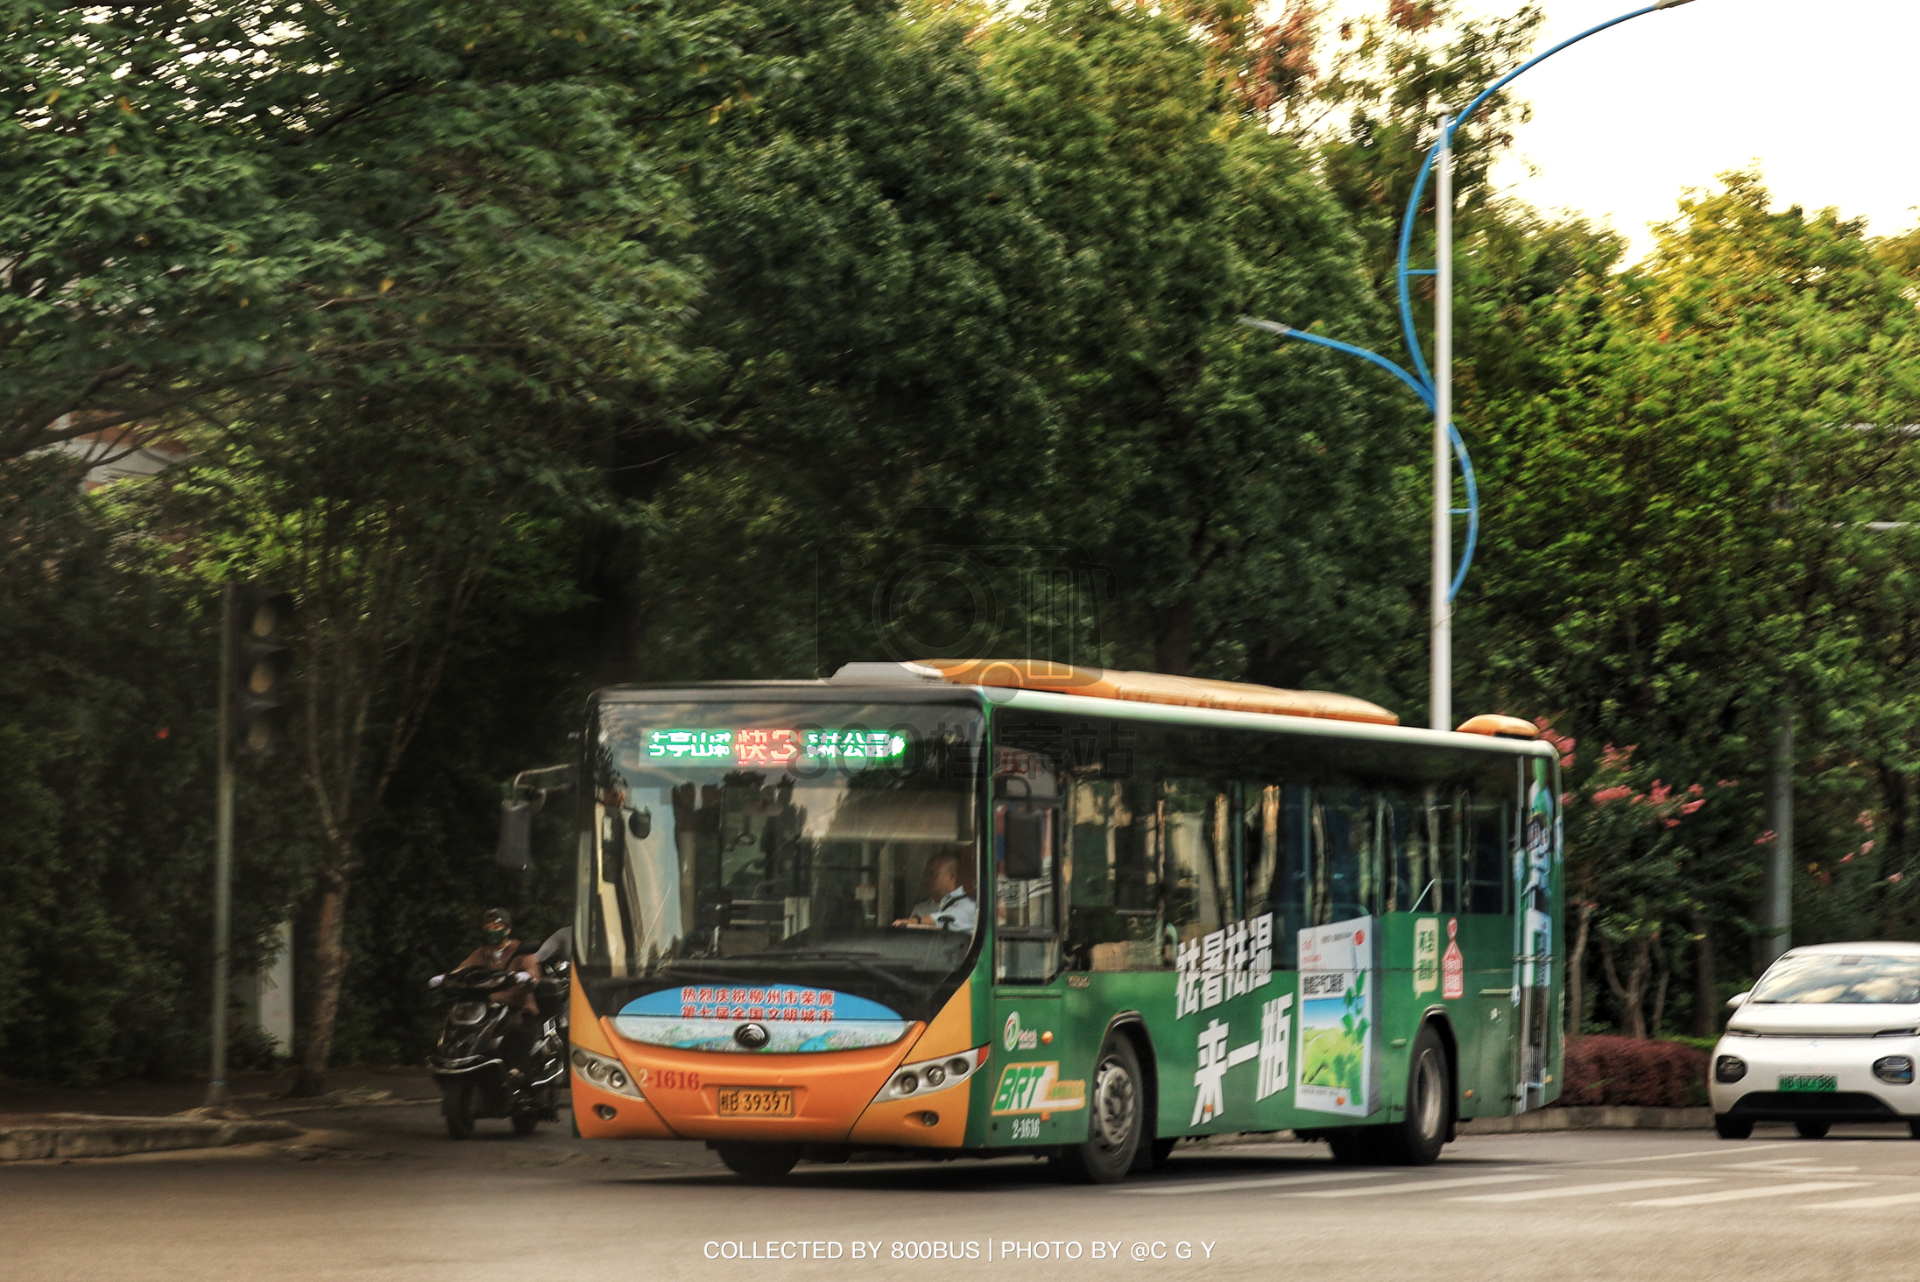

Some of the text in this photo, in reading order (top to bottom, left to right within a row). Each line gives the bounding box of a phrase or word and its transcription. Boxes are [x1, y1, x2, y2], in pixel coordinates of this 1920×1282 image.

[680, 986, 836, 1007] 热烈庆祝柳州市荣膺
[680, 1004, 836, 1023] 第七届全国文明城市
[1190, 992, 1293, 1127] 来一瓶
[638, 1068, 701, 1091] 2-1616
[993, 1066, 1046, 1111] BRT
[1011, 1118, 1040, 1139] 2-1616
